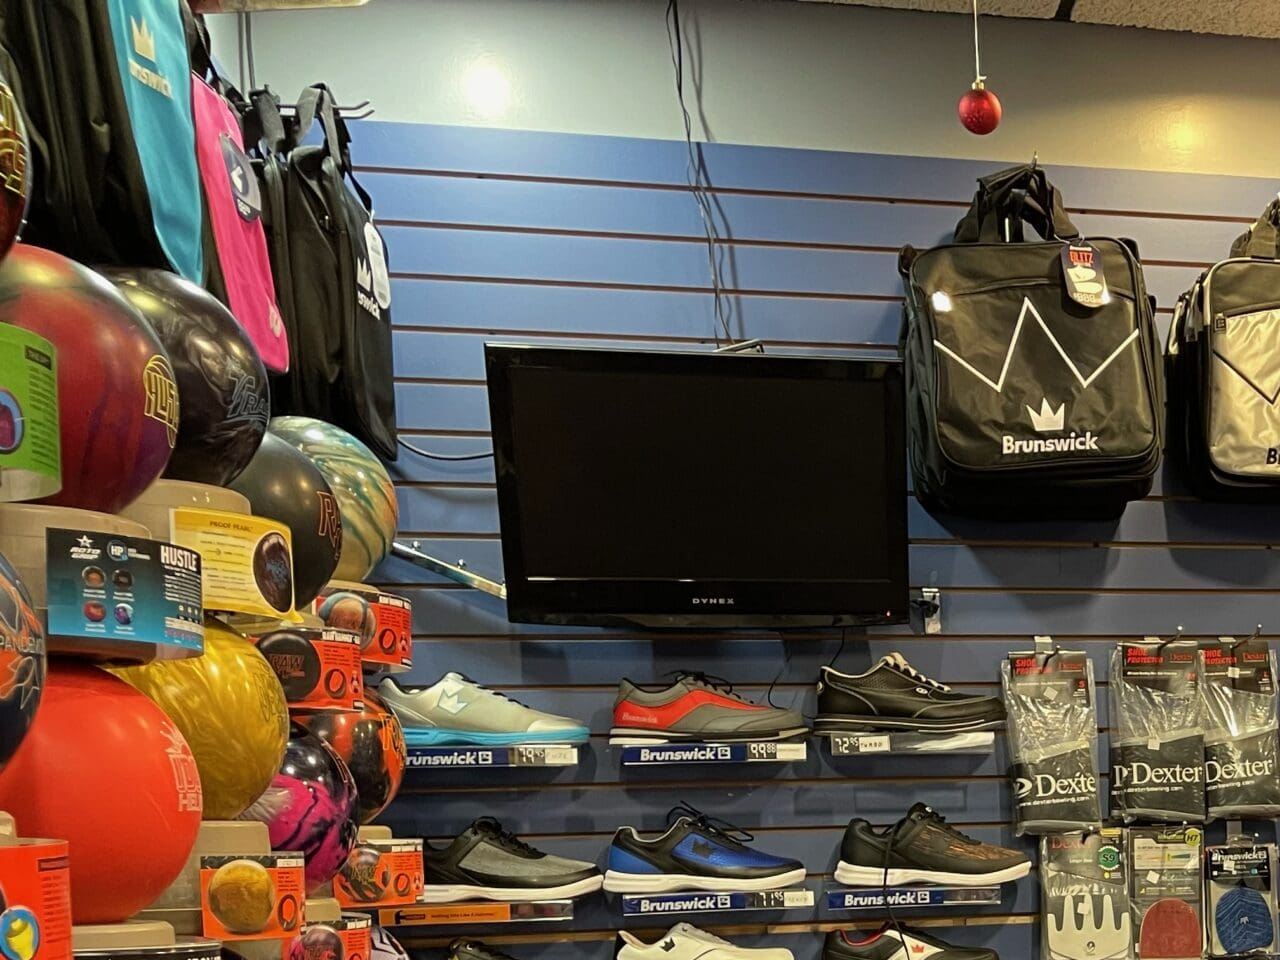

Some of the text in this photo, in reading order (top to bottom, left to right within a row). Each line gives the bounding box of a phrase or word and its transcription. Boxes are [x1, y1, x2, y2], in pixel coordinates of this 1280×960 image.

[1002, 432, 1098, 455] Brunswick
[160, 545, 199, 572] HUSTLE
[1127, 648, 1148, 656] SHOE
[405, 748, 477, 765] runswick
[640, 746, 713, 762] Brunswick
[1131, 761, 1203, 786] Dexter
[1205, 758, 1273, 784] Dexter
[1036, 773, 1098, 797] Dexte
[640, 895, 713, 912] Brunswick
